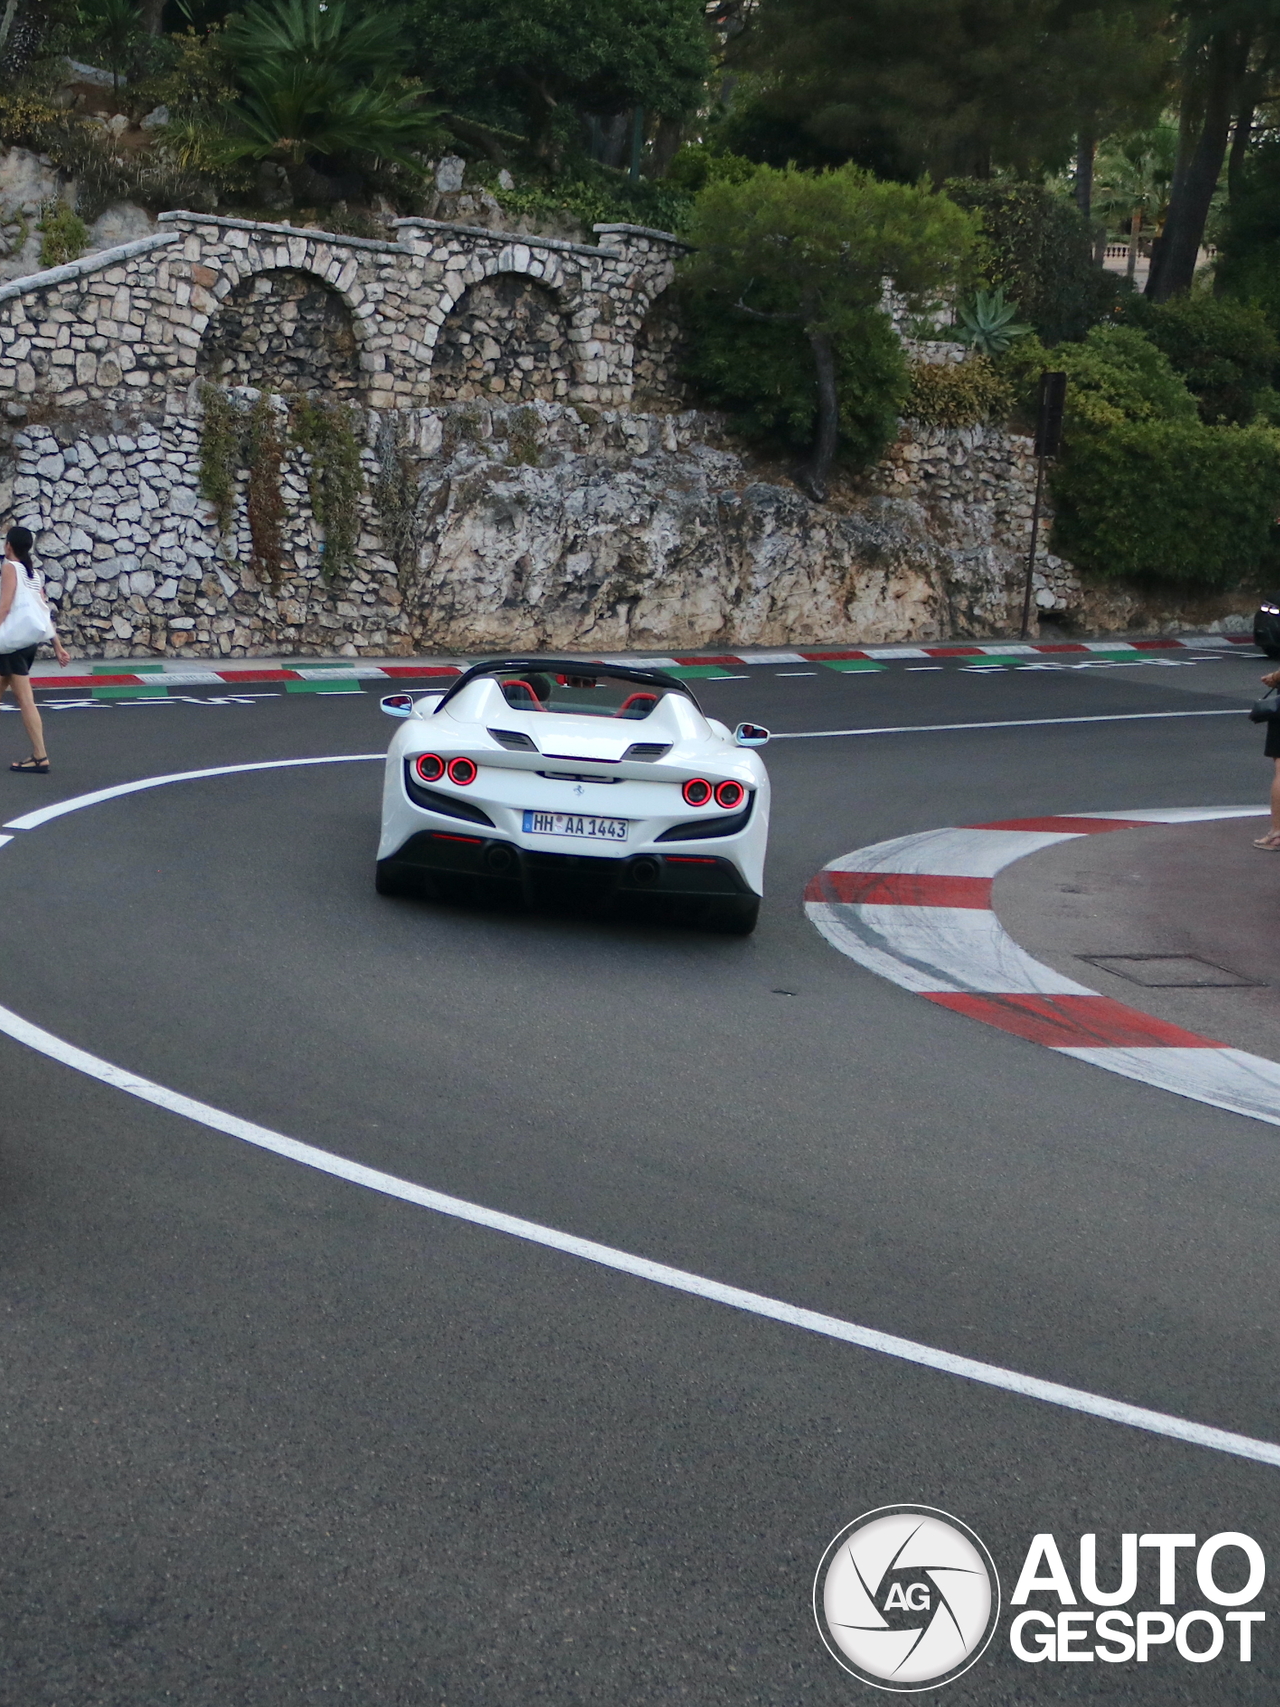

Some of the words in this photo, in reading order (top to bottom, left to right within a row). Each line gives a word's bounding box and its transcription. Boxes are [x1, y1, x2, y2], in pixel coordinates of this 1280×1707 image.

[533, 814, 554, 832] HH
[565, 817, 584, 835] AA
[587, 819, 627, 838] 1443
